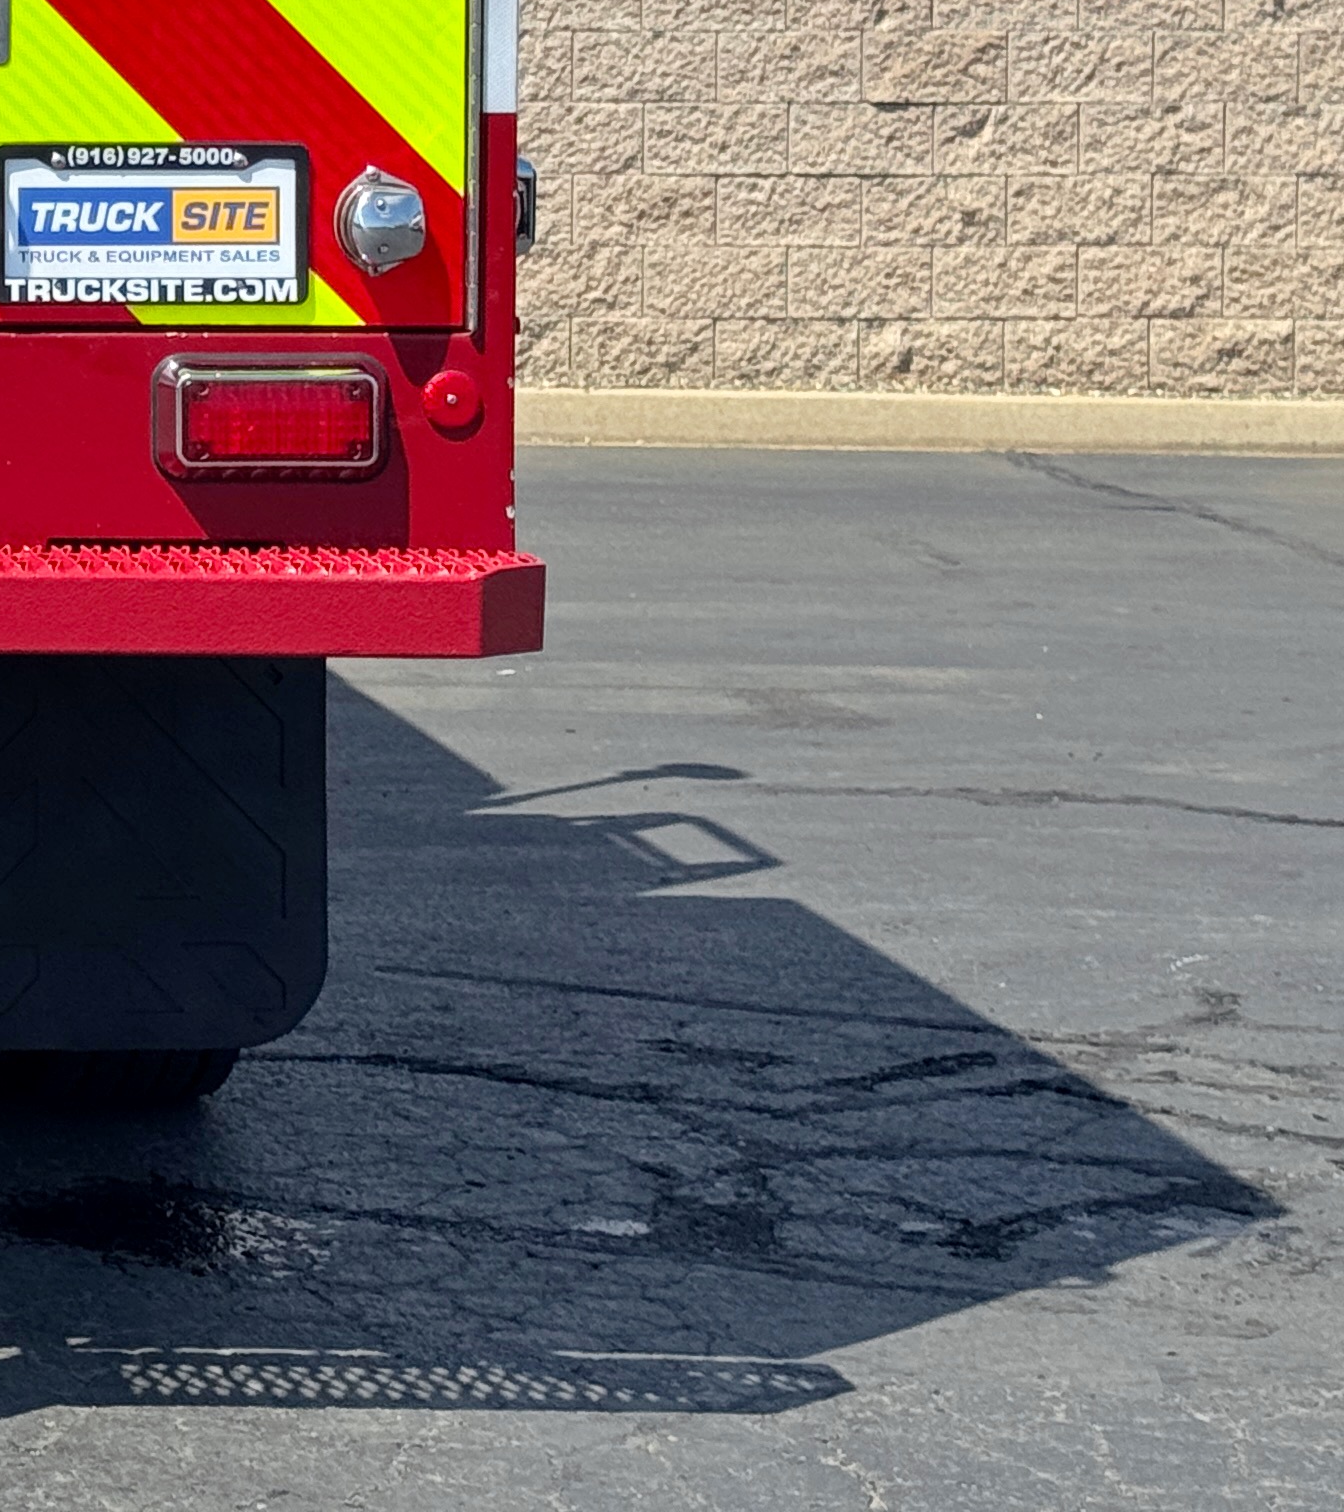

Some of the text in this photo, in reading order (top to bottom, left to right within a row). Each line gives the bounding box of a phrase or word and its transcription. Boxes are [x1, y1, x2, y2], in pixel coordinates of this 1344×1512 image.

[67, 146, 234, 167] (916) 927-5000
[31, 201, 269, 232] TRUCK SITE
[18, 250, 280, 263] TRUCK & EQUIPMENT SALES
[4, 278, 298, 303] TRUCKSITE.COM
